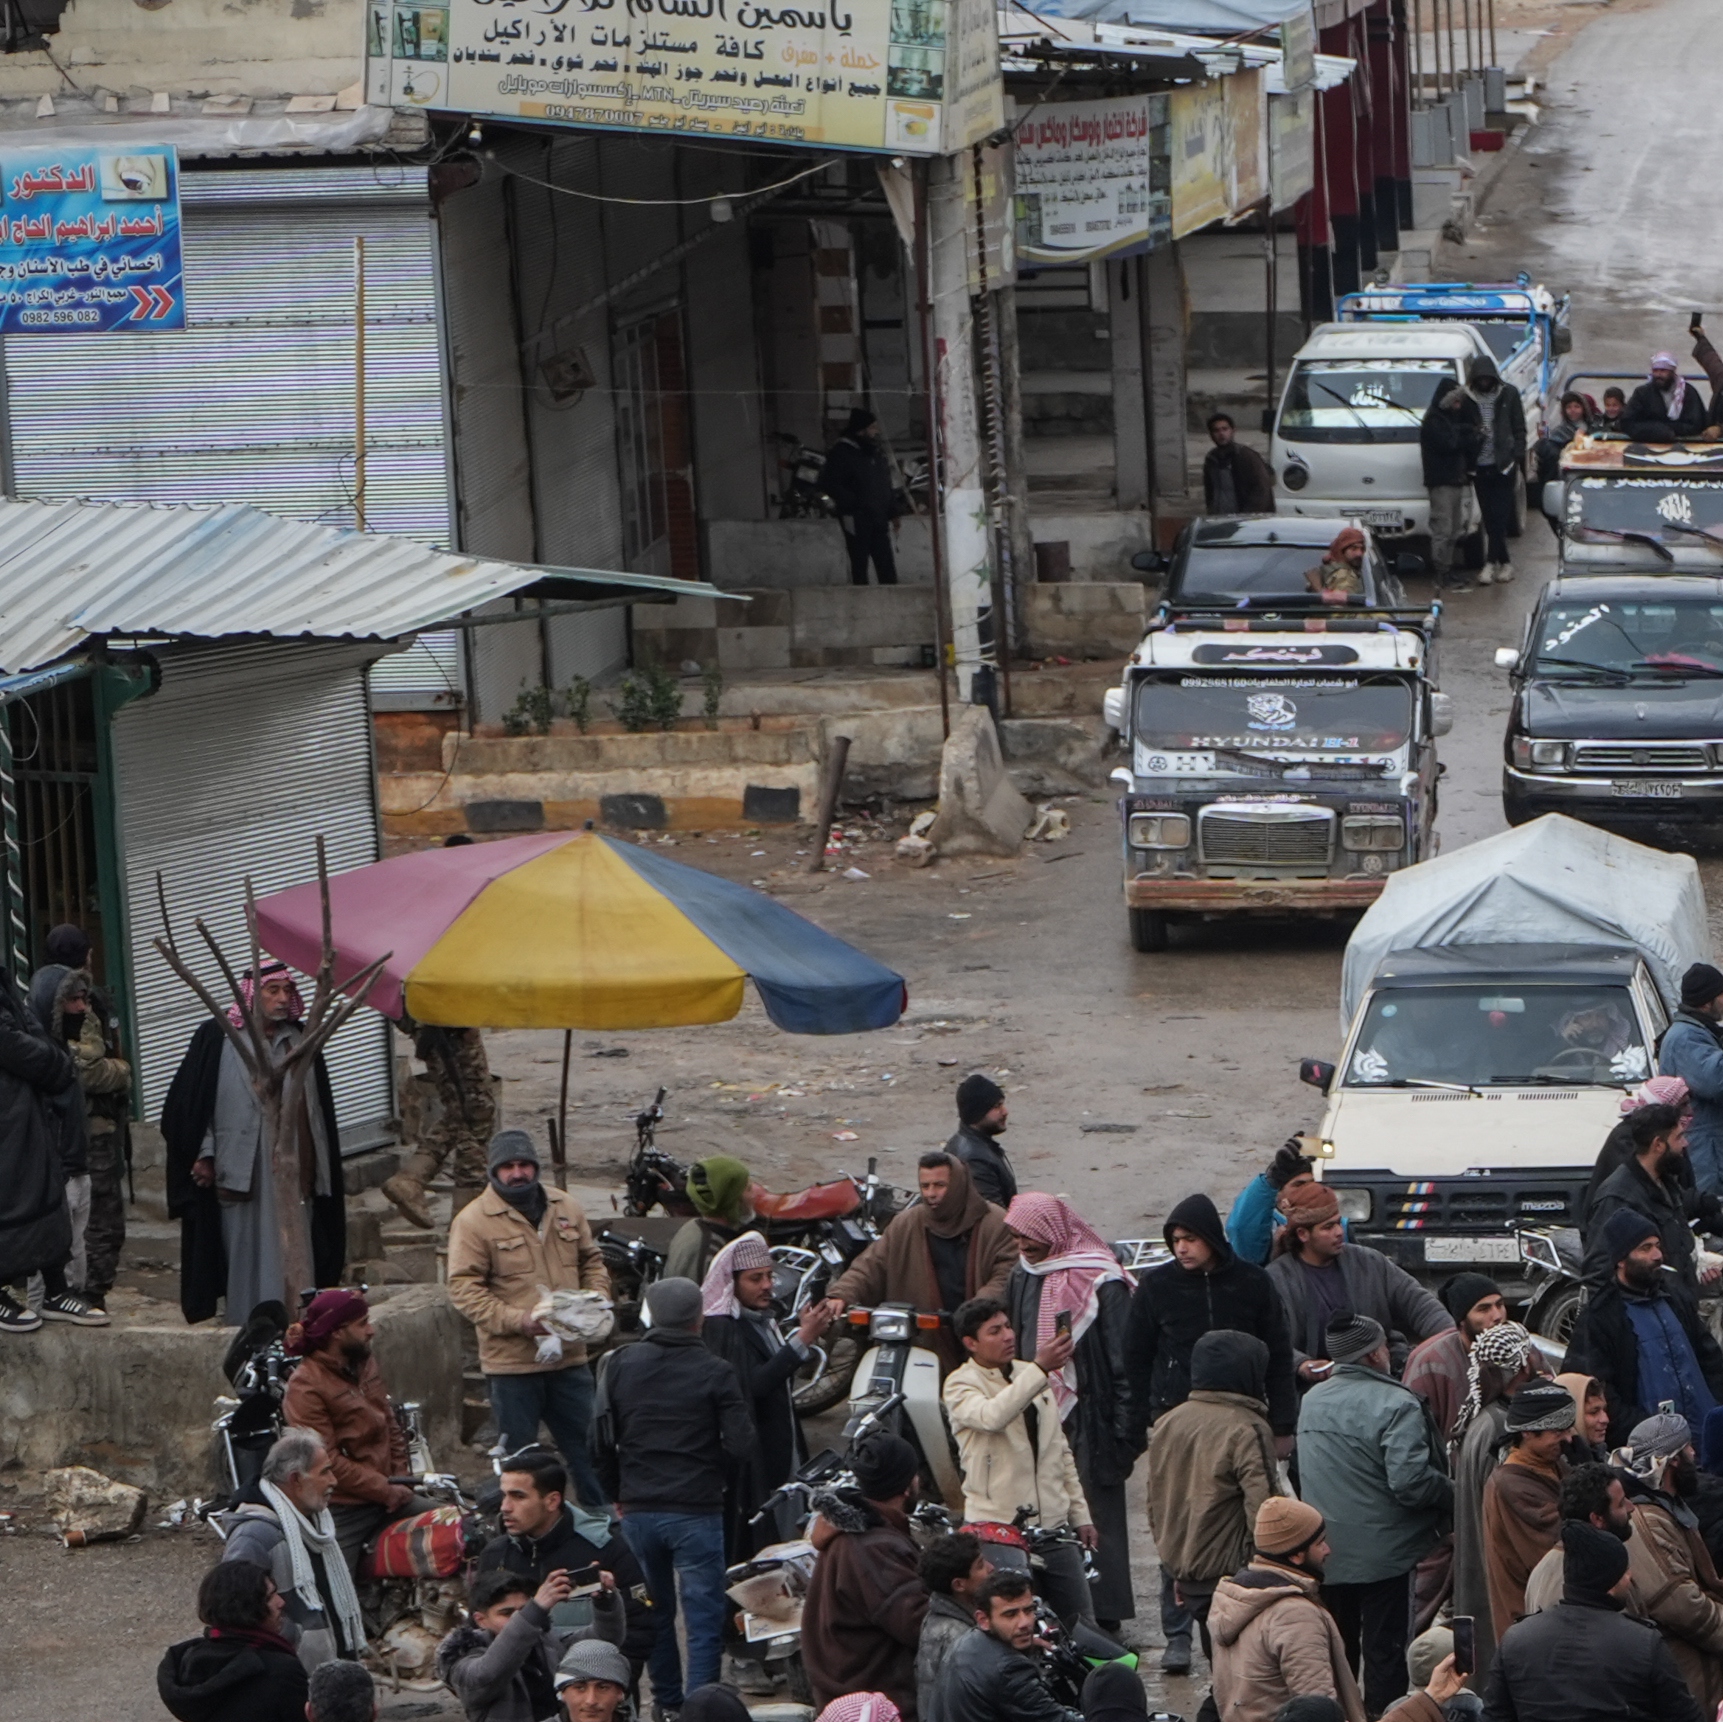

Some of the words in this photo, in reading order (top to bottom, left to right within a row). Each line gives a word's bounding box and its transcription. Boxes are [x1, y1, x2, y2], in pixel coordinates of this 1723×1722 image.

[483, 18, 576, 46] الأراكيل
[590, 25, 698, 55] مستلزمات
[505, 50, 536, 66] فحم
[716, 35, 766, 61] كافة
[781, 40, 819, 67] مفرق
[551, 53, 584, 74] شوي
[589, 56, 619, 73] فحم
[840, 45, 881, 75] جملة
[675, 63, 704, 82] جوز
[709, 66, 748, 86] وفحم
[753, 70, 800, 88] المعسل
[499, 74, 549, 97] موبايل
[848, 82, 882, 99] جميع
[8, 163, 96, 199] الدكتور
[12, 213, 51, 244] الحاج
[55, 213, 117, 245] ابراهيم
[119, 204, 164, 237] أحمد
[17, 258, 64, 279] الأسنان
[67, 259, 90, 276] طب
[93, 258, 109, 280] في
[112, 253, 162, 280] أخصائي
[26, 287, 53, 306] الكراج
[107, 289, 127, 303] مجمع
[22, 311, 50, 325] 0982
[53, 310, 75, 323] 596
[77, 310, 98, 323] 082
[1189, 736, 1319, 748] HYUNDAI
[1521, 1200, 1566, 1211] mazda
